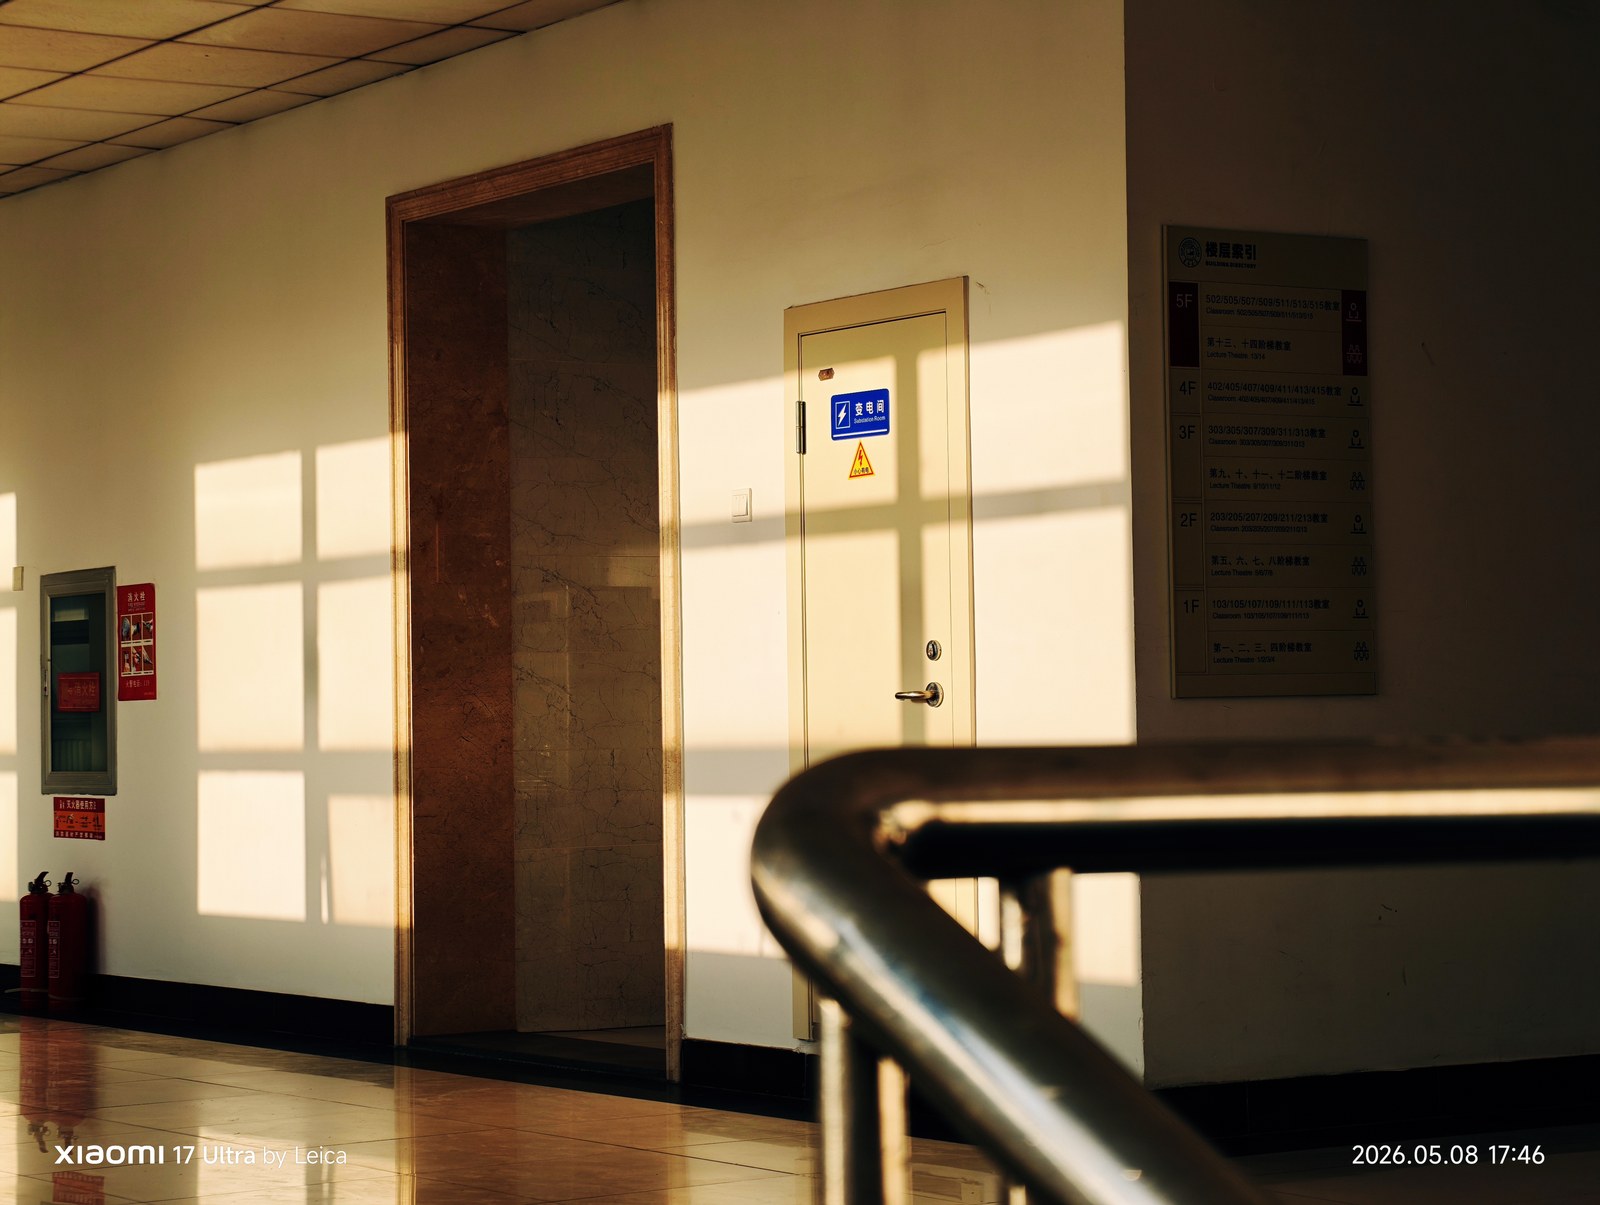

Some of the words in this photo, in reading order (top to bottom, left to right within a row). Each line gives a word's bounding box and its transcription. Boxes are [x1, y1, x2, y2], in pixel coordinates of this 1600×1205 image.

[1206, 241, 1257, 260] 楼层索引
[1230, 261, 1256, 269] DIRECTORY
[1176, 292, 1193, 308] 5F
[1207, 336, 1291, 352] 第十三、十四阶梯教室
[1179, 380, 1197, 395] 4F
[1207, 382, 1343, 397] 402/405/407/409/411/413/415教室
[855, 400, 884, 416] 变电间
[1178, 425, 1196, 440] 3F
[1208, 425, 1326, 439] 303/305/307/309/311/313教室
[1209, 467, 1328, 481] 第九、十、十一、十二阶梯教室
[1180, 512, 1197, 527] 2F
[1210, 512, 1328, 524] 203/205/207/209/211/213教室
[1211, 555, 1310, 566] 第五、六、七、八阶梯教室
[1211, 568, 1232, 577] Lecture
[127, 591, 146, 603] 消火栓
[1183, 599, 1199, 614] 1F
[1212, 599, 1330, 610] 103/105/107/109/111/113教室
[1213, 642, 1312, 654] 第一、二、三、四阶梯教室
[1213, 656, 1234, 665] Lecture
